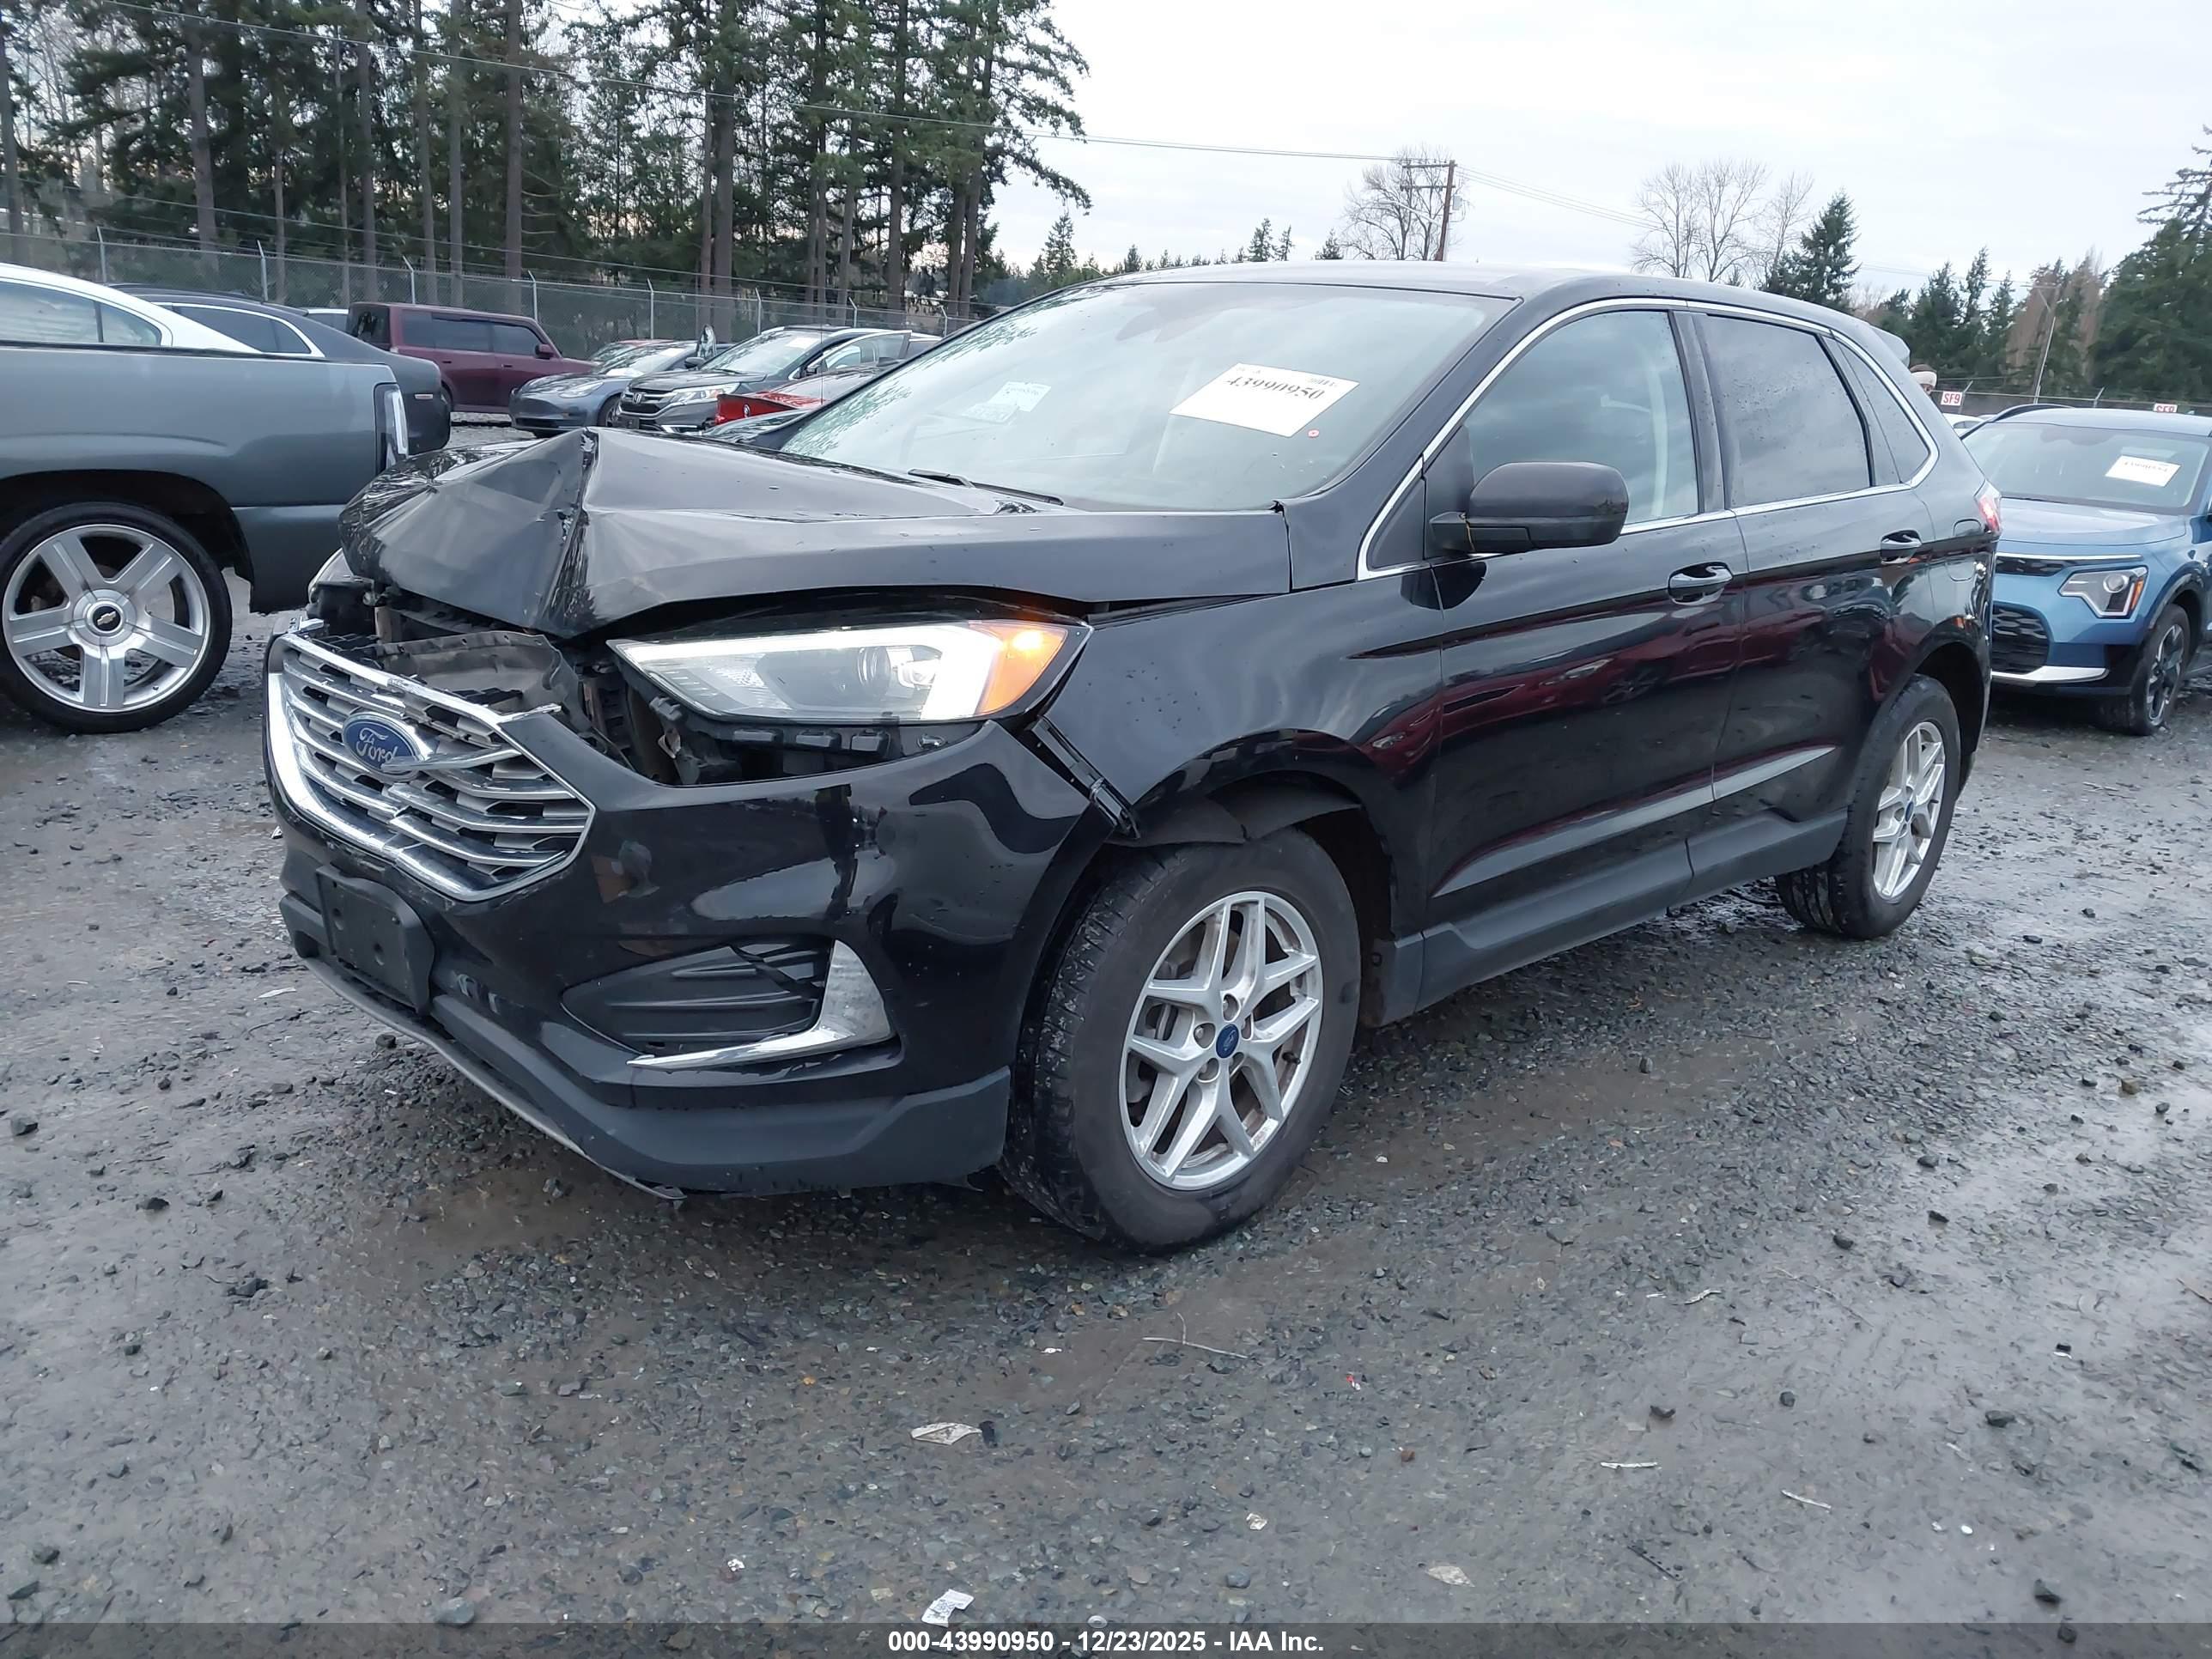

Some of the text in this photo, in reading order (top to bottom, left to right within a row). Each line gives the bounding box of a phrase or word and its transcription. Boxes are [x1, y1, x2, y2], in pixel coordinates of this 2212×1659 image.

[1225, 375, 1326, 400] 43990950
[1942, 392, 1961, 404] SF9
[356, 727, 398, 762] Ford
